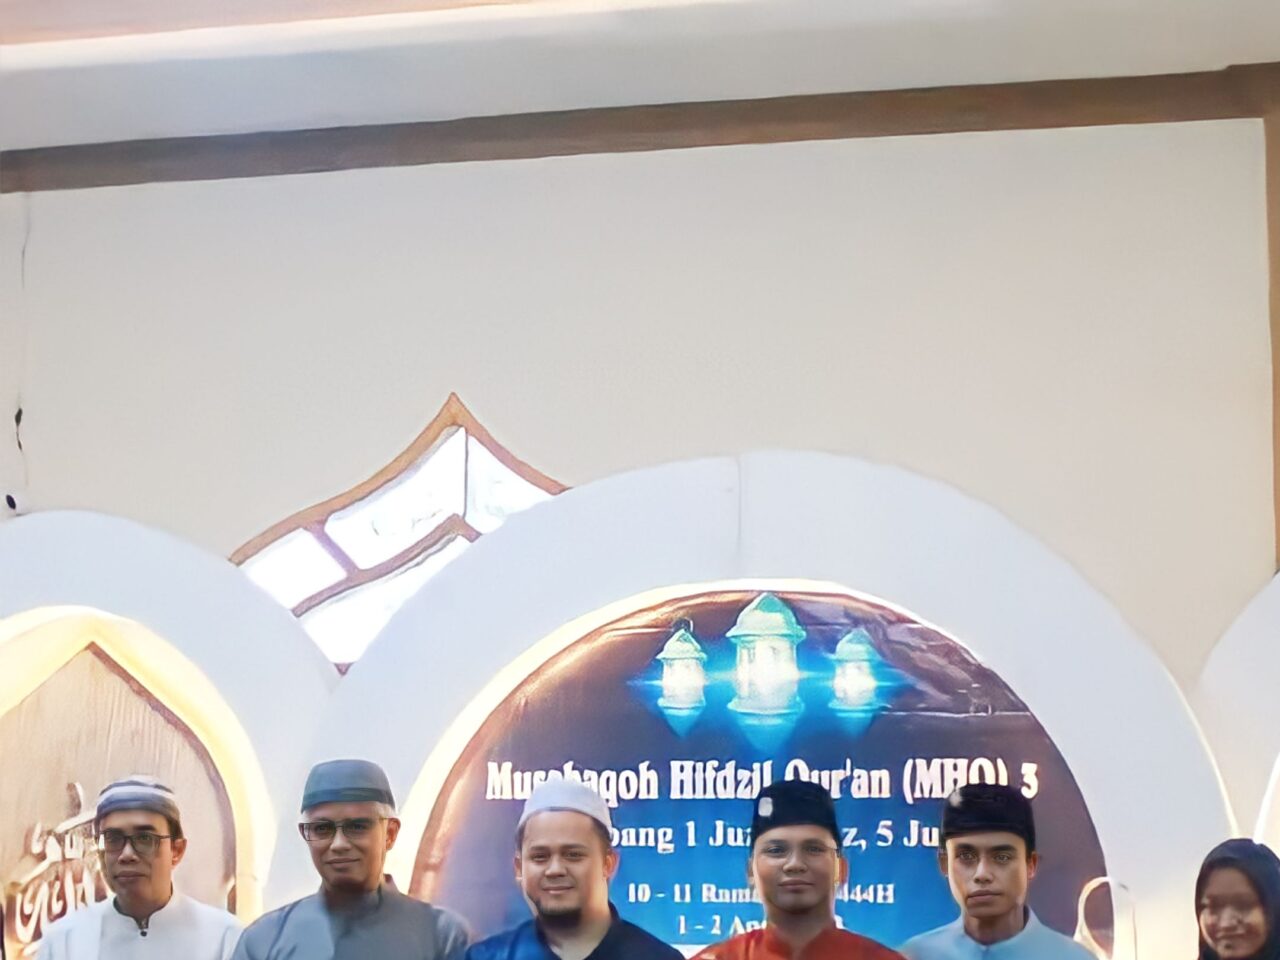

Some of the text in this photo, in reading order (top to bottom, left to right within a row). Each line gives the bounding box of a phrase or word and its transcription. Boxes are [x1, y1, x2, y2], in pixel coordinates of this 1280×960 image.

[1020, 762, 1039, 799] 3
[686, 820, 697, 847] 1
[876, 820, 894, 847] 5
[903, 819, 940, 848] Ju
[628, 882, 651, 904] 10
[673, 883, 691, 904] 11
[678, 914, 687, 935] 1
[710, 914, 722, 935] 2
